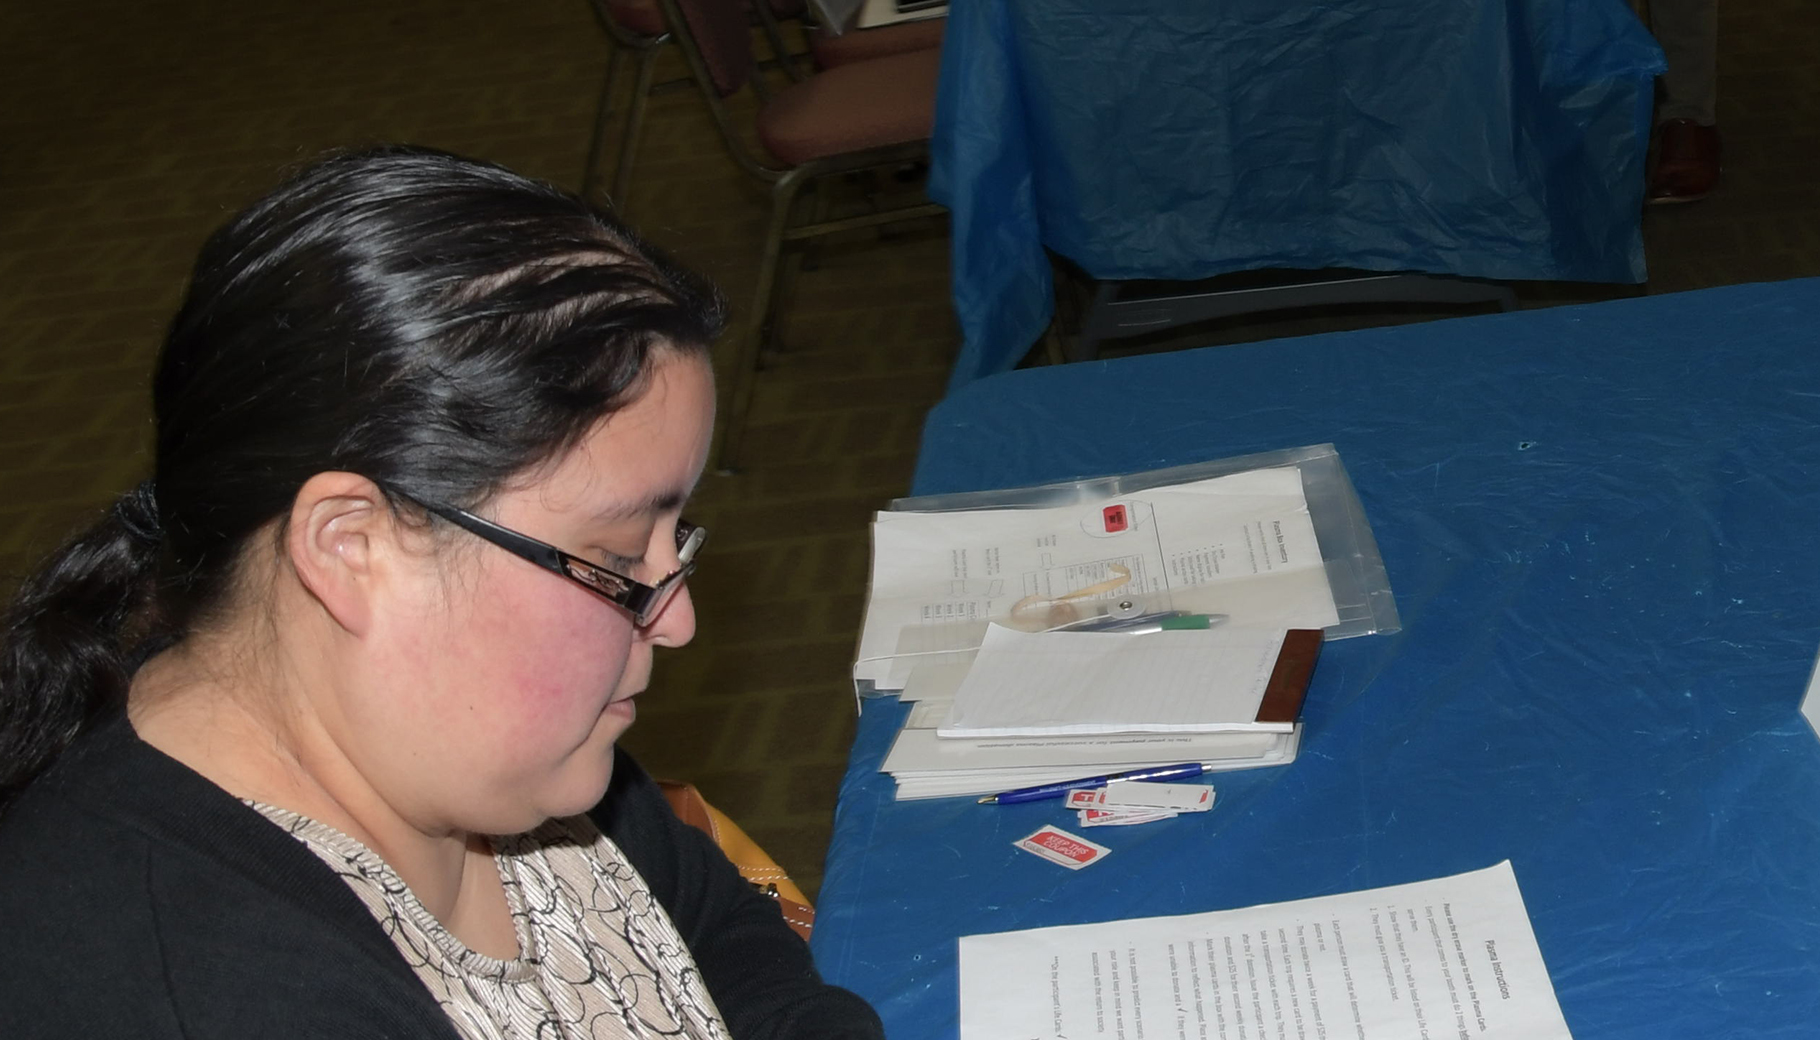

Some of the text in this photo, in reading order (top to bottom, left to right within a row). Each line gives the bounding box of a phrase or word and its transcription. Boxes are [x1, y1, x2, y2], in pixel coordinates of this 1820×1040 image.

[1043, 840, 1080, 858] COUPON
[1047, 835, 1089, 855] KEEP THIS
[1485, 940, 1510, 999] Plasma Instructions
